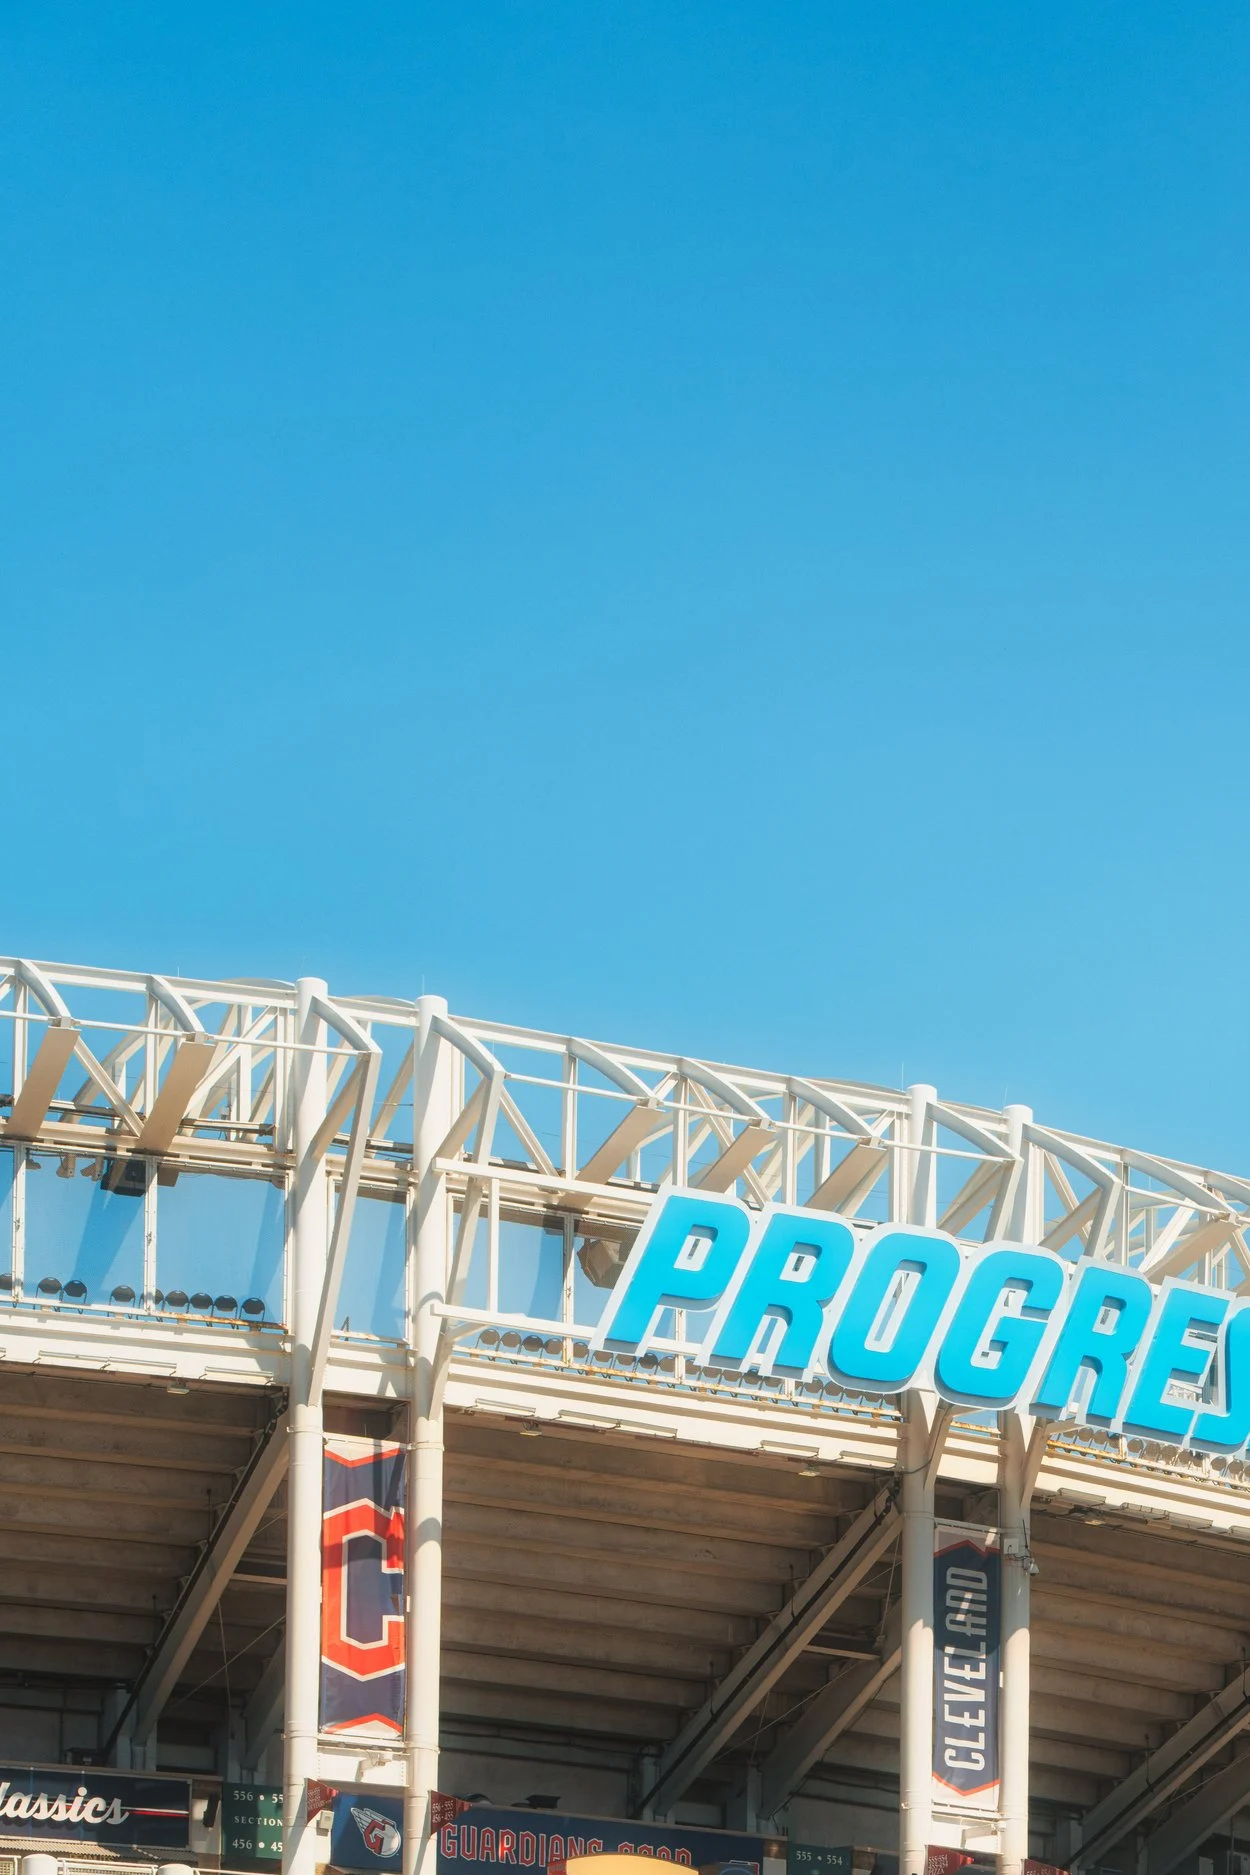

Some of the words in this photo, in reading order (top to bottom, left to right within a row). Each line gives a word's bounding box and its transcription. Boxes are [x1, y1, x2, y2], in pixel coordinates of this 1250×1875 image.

[943, 1566, 988, 1772] CLEVELAND
[0, 1782, 130, 1825] lassics
[233, 1790, 254, 1801] 556
[271, 1793, 283, 1804] 55
[234, 1815, 283, 1827] SECTION
[232, 1839, 253, 1849] 456
[271, 1841, 283, 1852] 45
[796, 1850, 812, 1862] 555
[826, 1854, 843, 1866] 554
